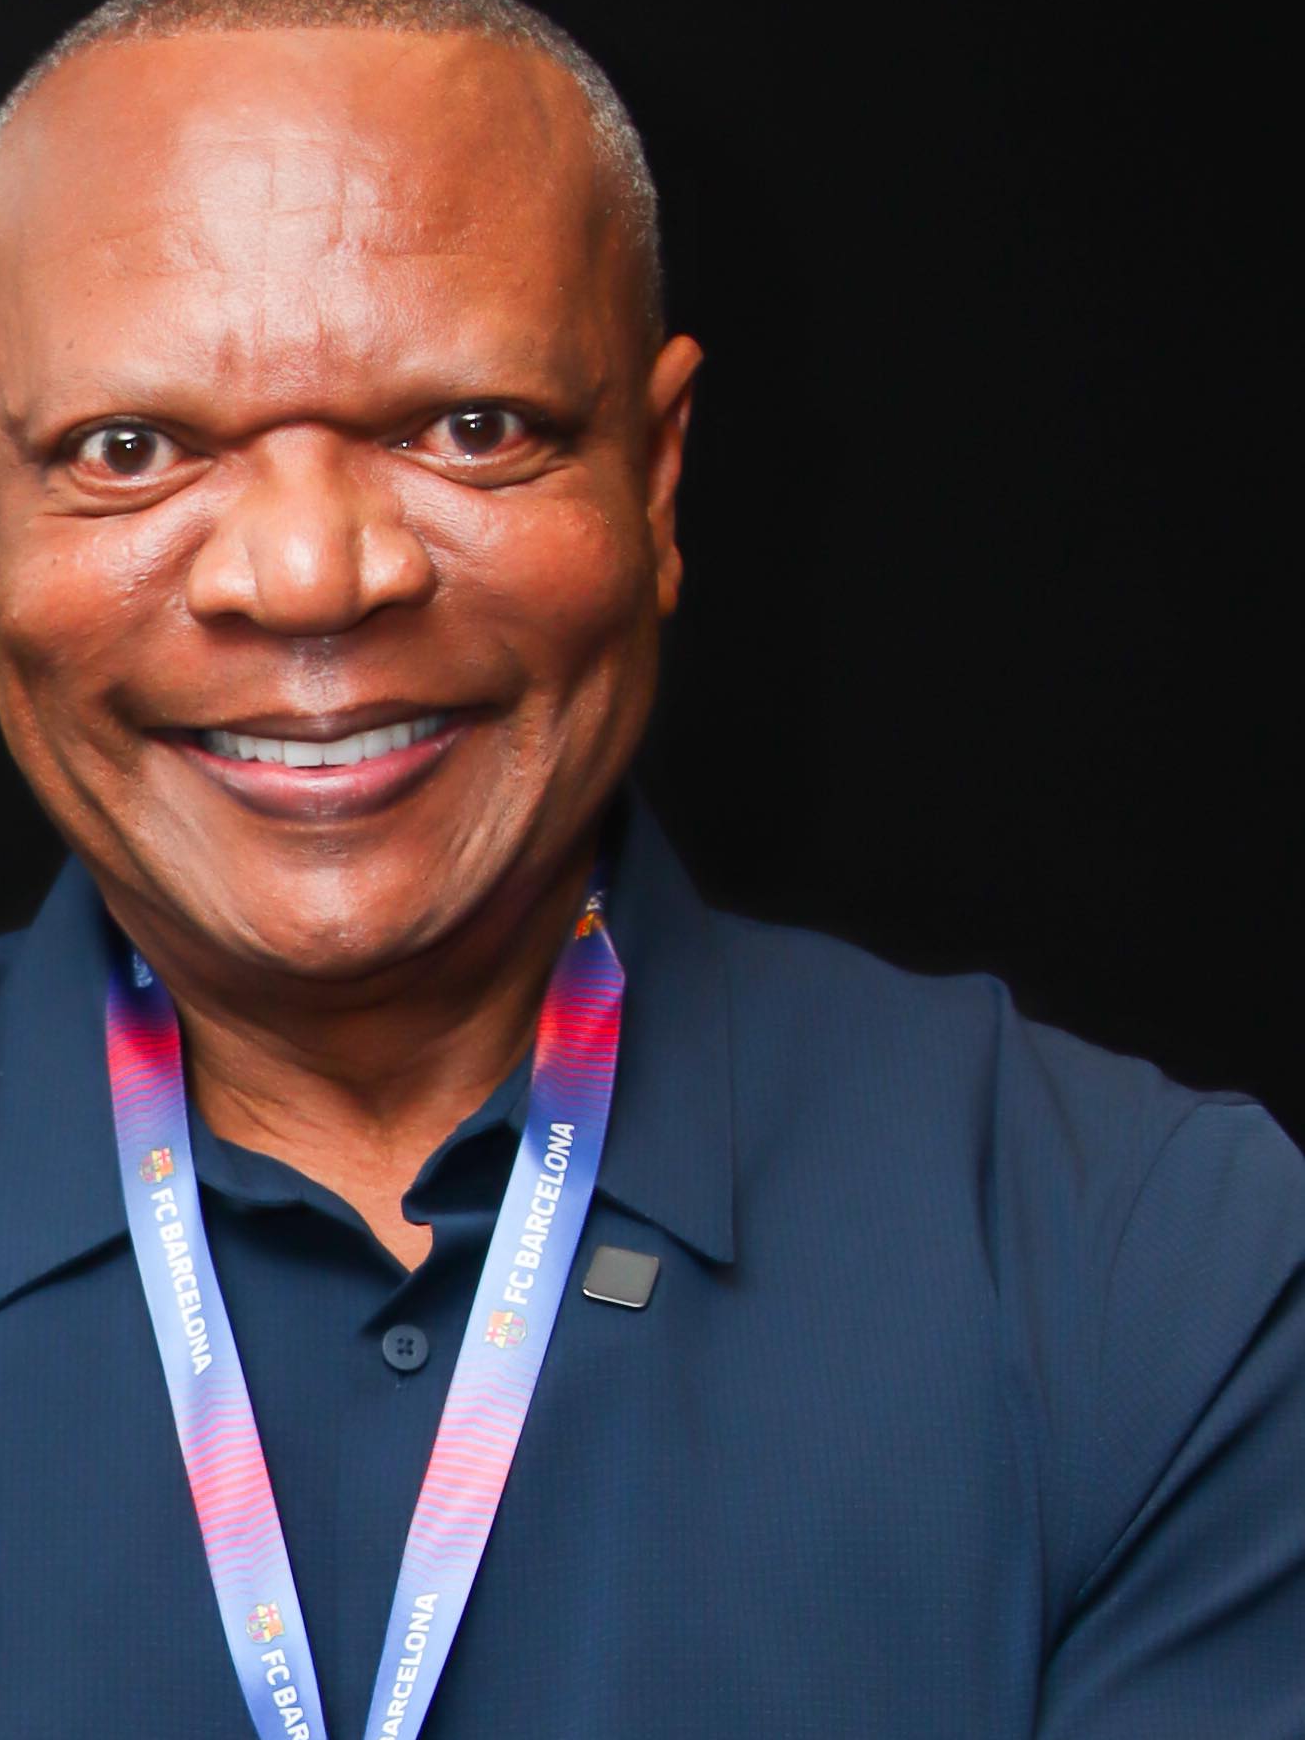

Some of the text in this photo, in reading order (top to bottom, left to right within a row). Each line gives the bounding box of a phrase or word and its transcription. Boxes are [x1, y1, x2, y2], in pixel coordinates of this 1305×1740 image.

[150, 1187, 213, 1376] FC BARCELONA
[503, 1122, 575, 1305] FC BARCELONA
[260, 1648, 290, 1686] FC
